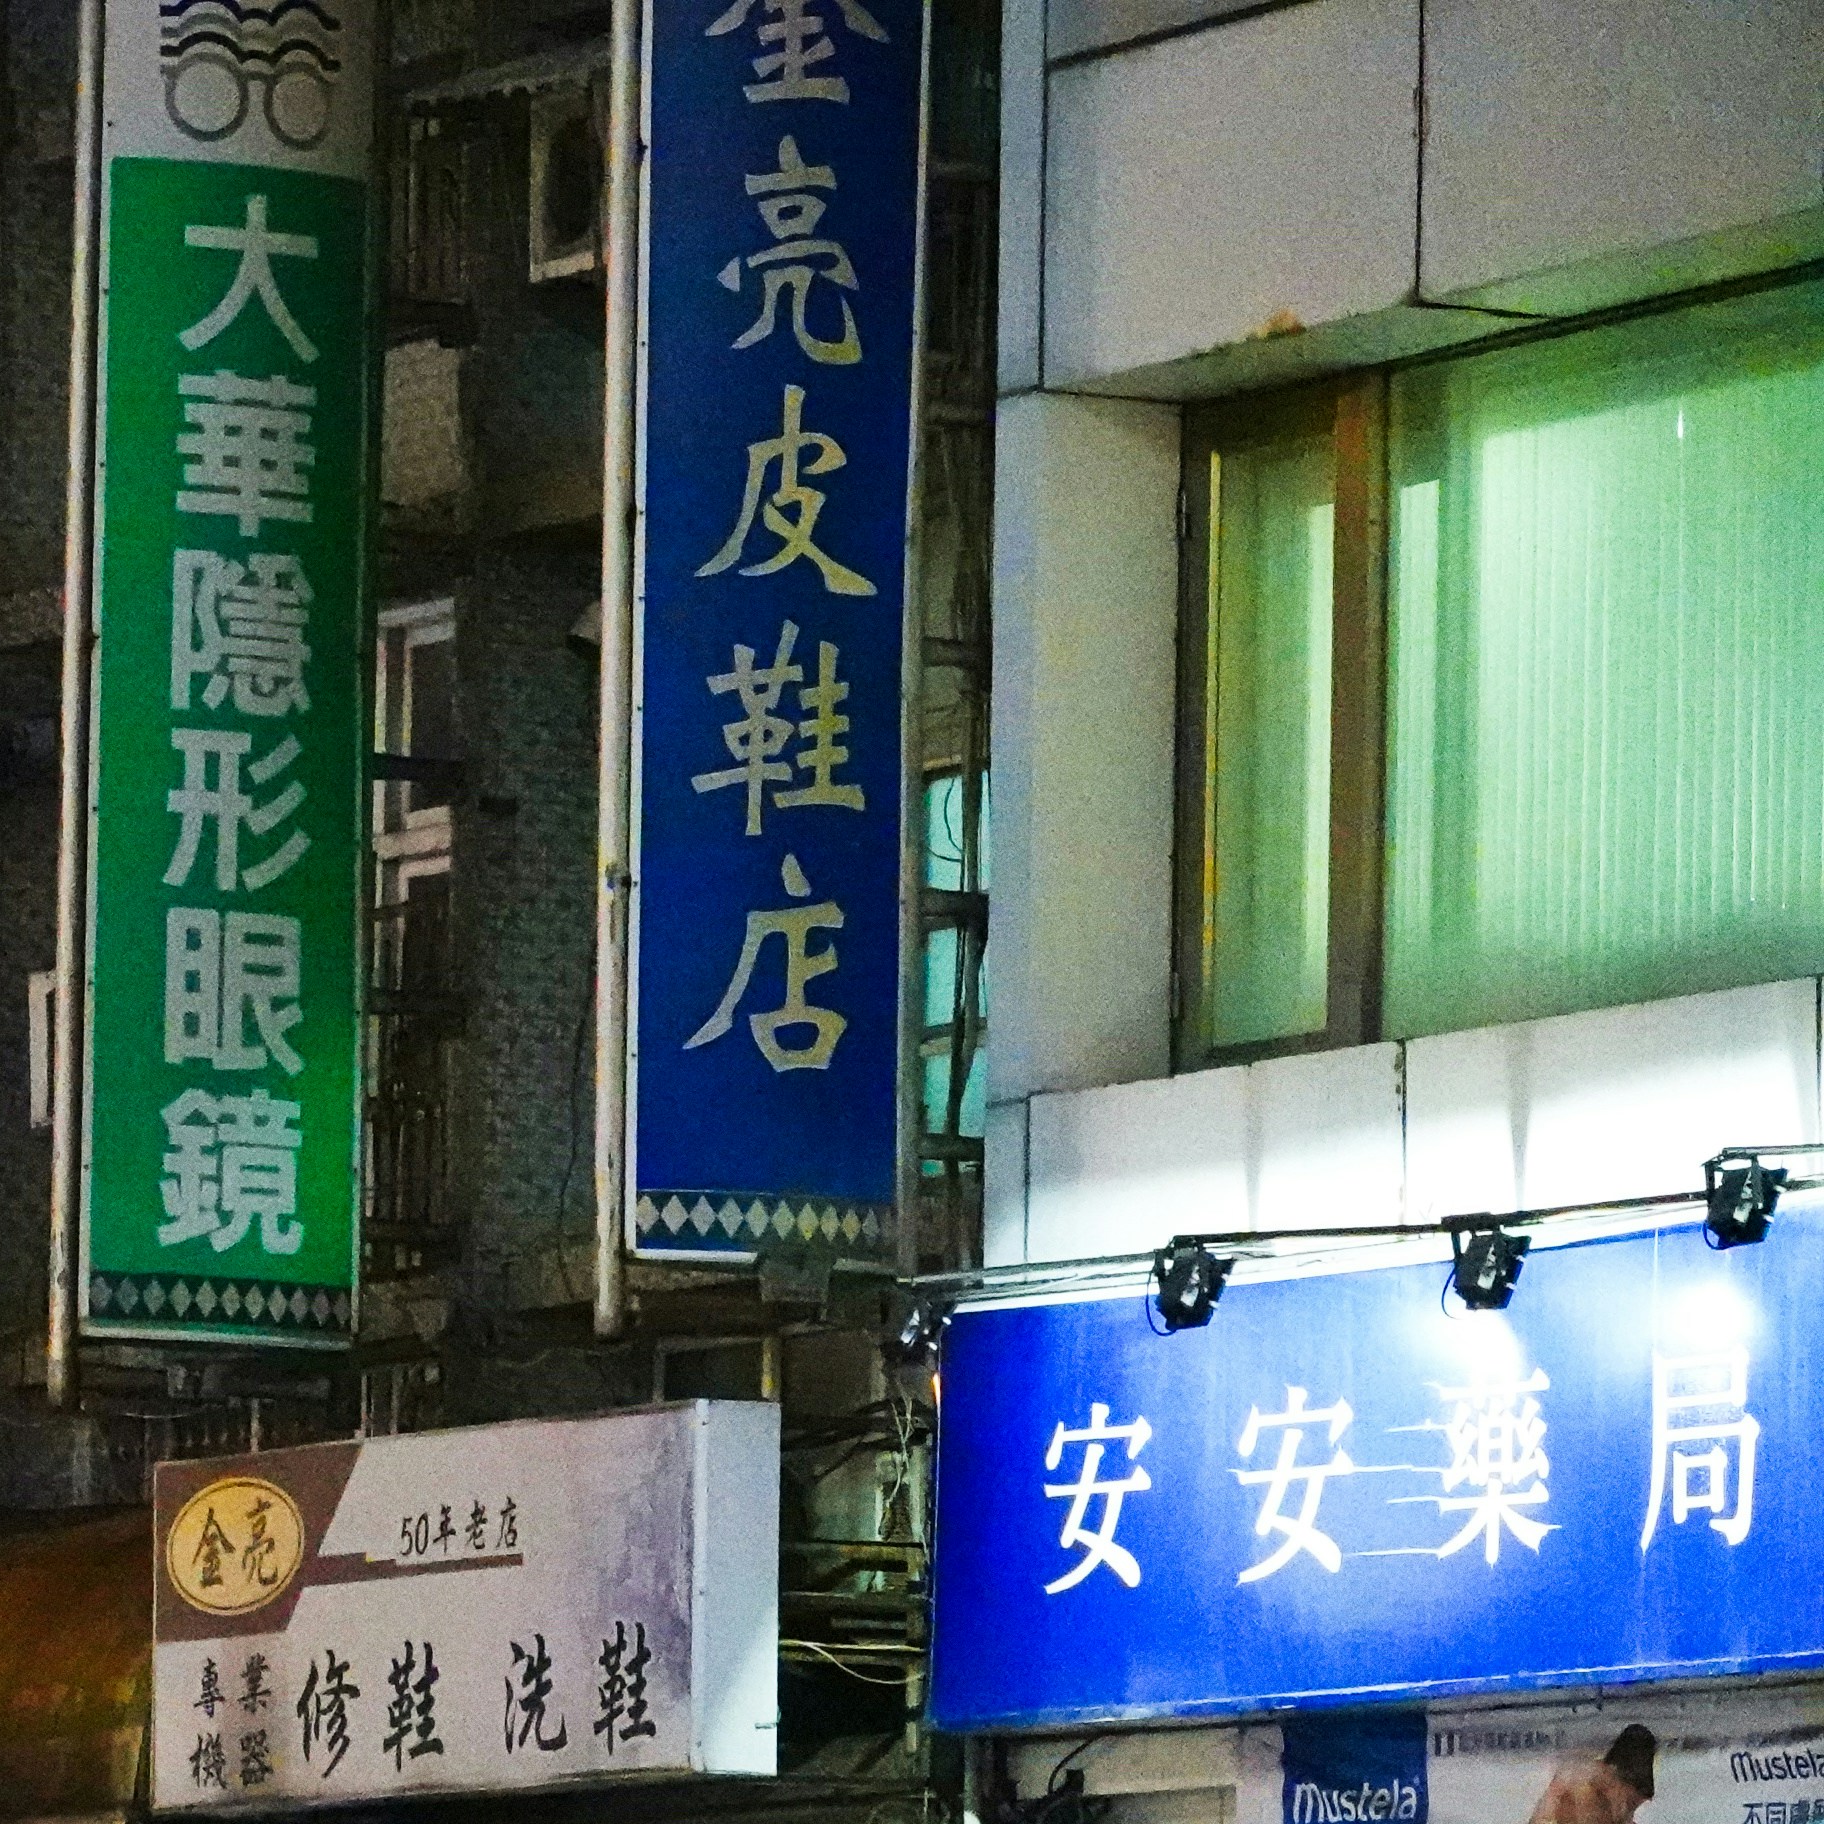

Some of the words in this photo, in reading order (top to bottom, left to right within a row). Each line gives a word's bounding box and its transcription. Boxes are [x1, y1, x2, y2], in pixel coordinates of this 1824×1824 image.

[156, 193, 320, 1261] 大華隱形眼鏡
[191, 1497, 280, 1589] 金亮
[400, 1496, 521, 1556] 50年老店
[1043, 1346, 1760, 1595] 安安藥局
